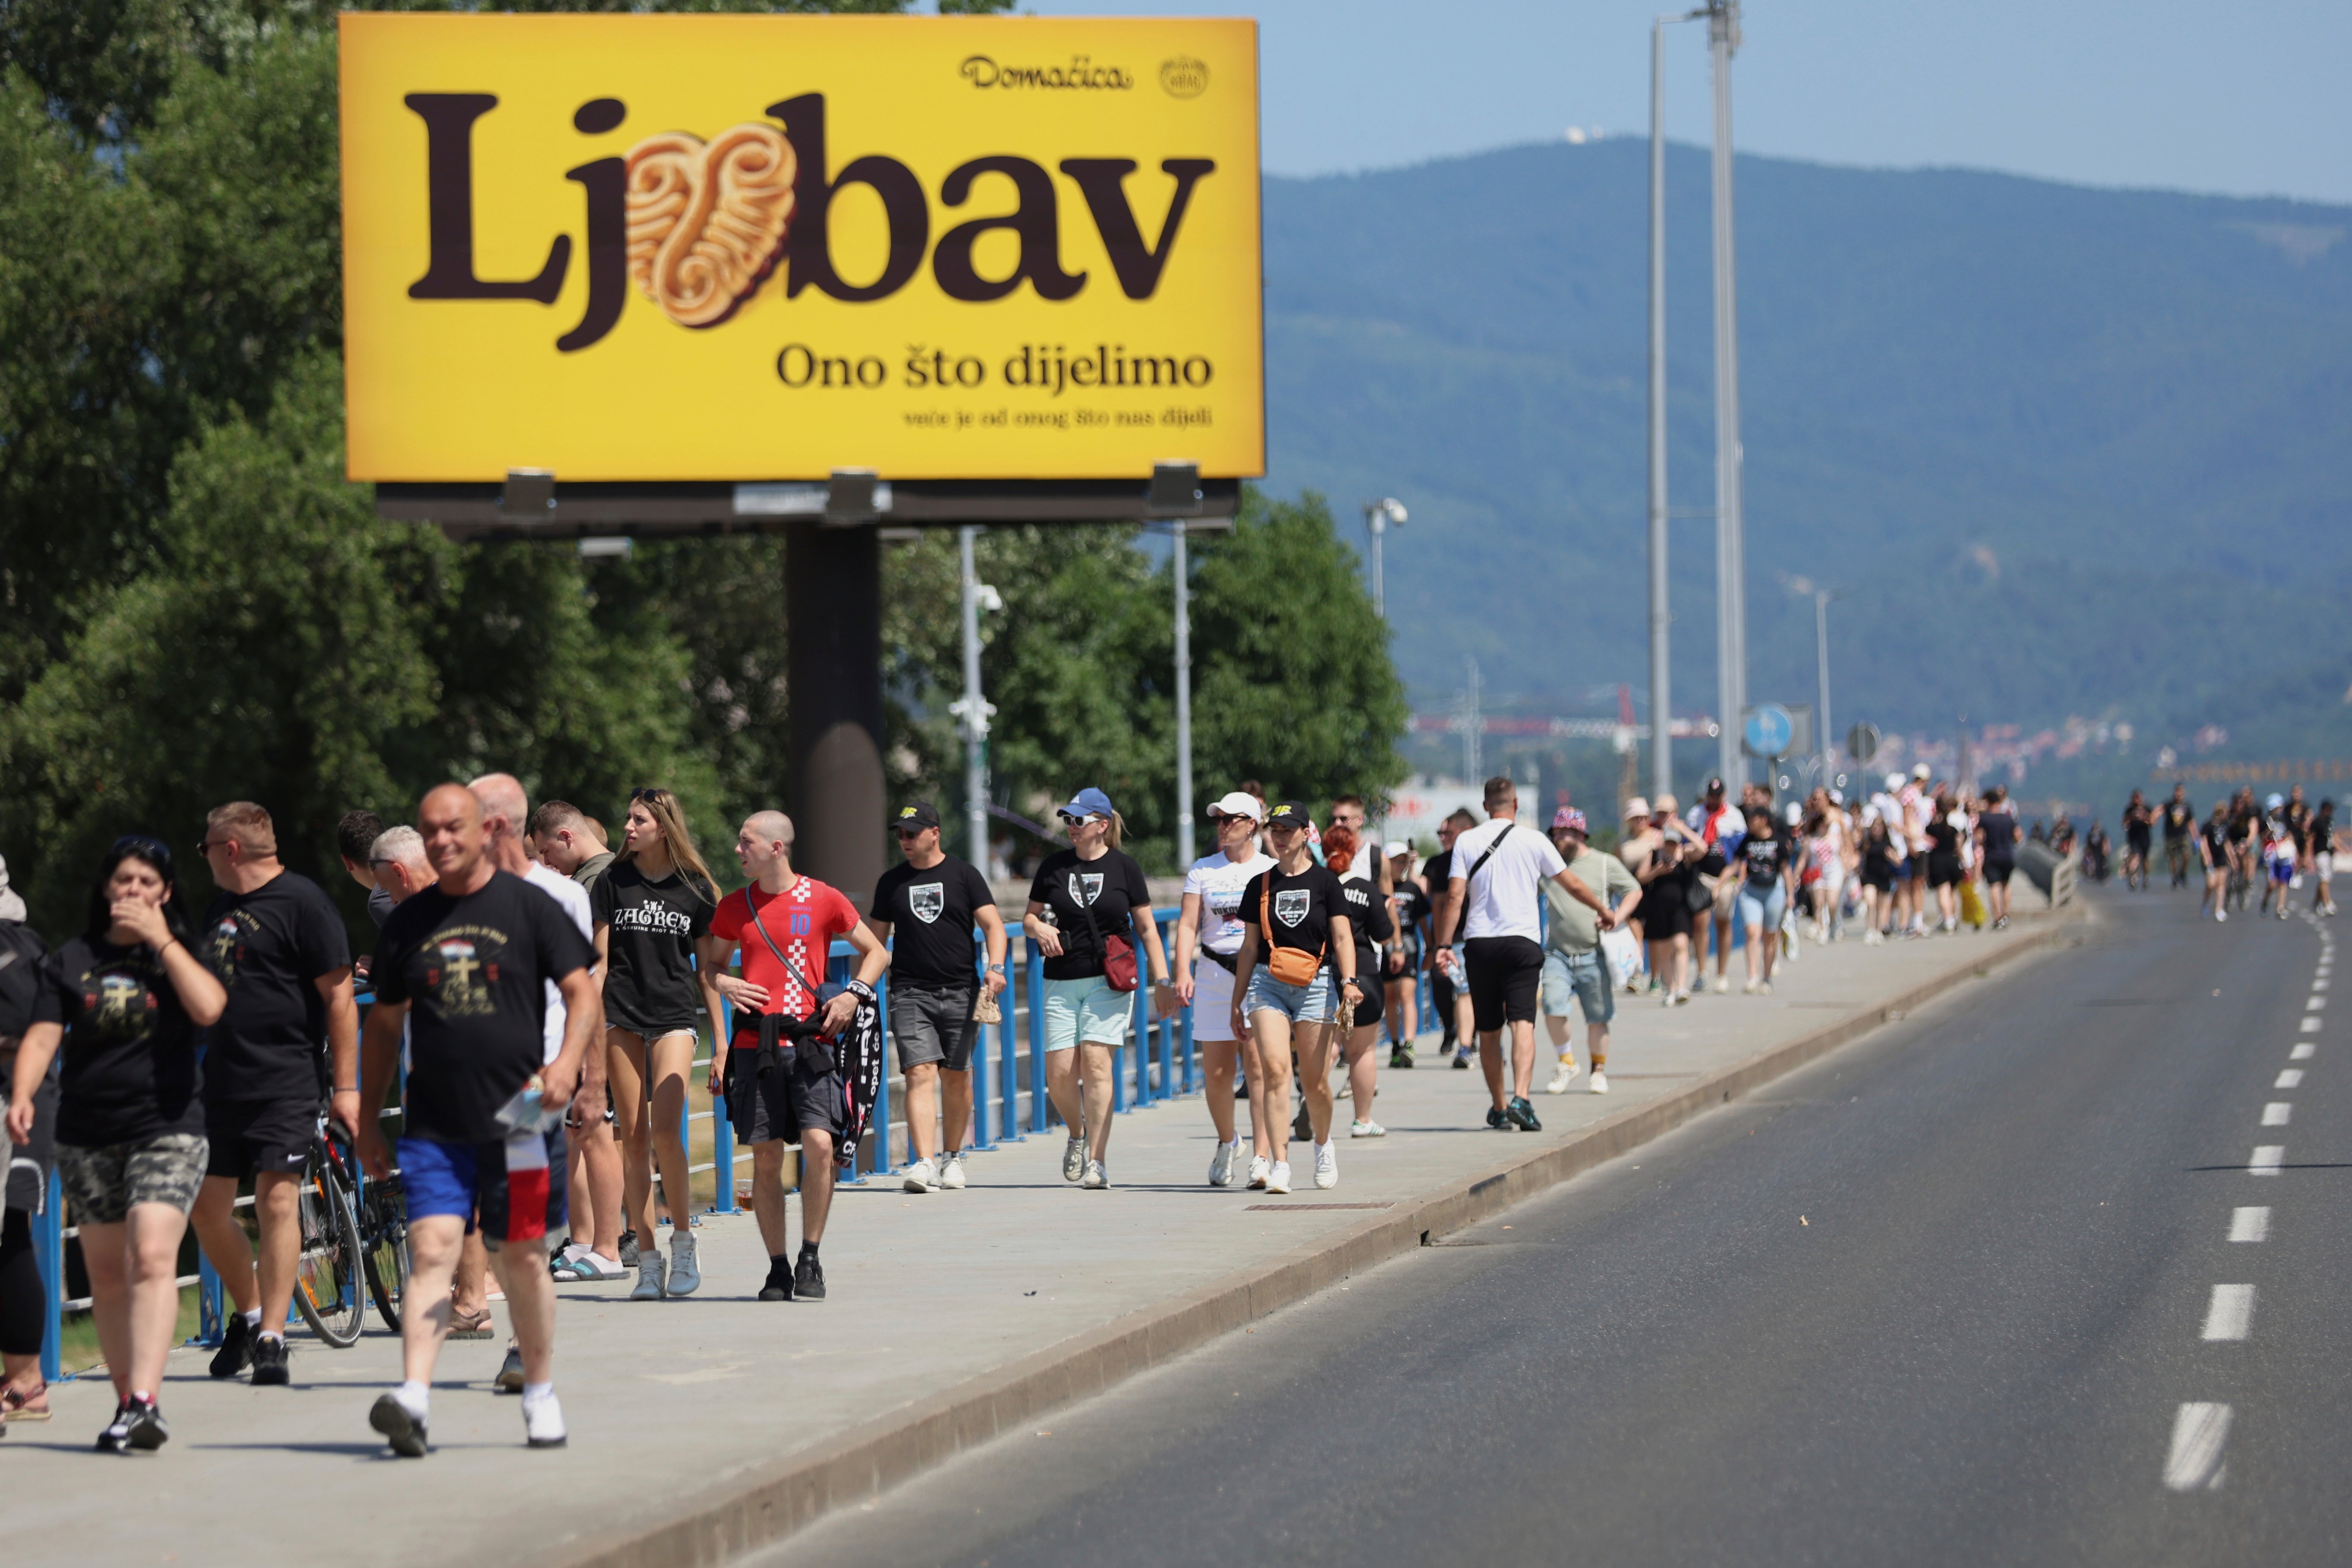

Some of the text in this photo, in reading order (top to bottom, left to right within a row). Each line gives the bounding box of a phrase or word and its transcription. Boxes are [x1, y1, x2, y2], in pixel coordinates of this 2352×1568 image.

[960, 54, 1132, 89] Domaćica
[402, 90, 1217, 354] Ljbav
[776, 343, 1214, 396] Ono što dijelimo
[956, 409, 971, 430] je
[981, 408, 1007, 426] od
[1016, 412, 1068, 430] onog
[1074, 407, 1109, 426] što
[1115, 412, 1154, 426] nas
[614, 908, 691, 932] ZAGREB
[791, 914, 810, 935] 10
[872, 1031, 880, 1052] će
[871, 1059, 880, 1097] opet
